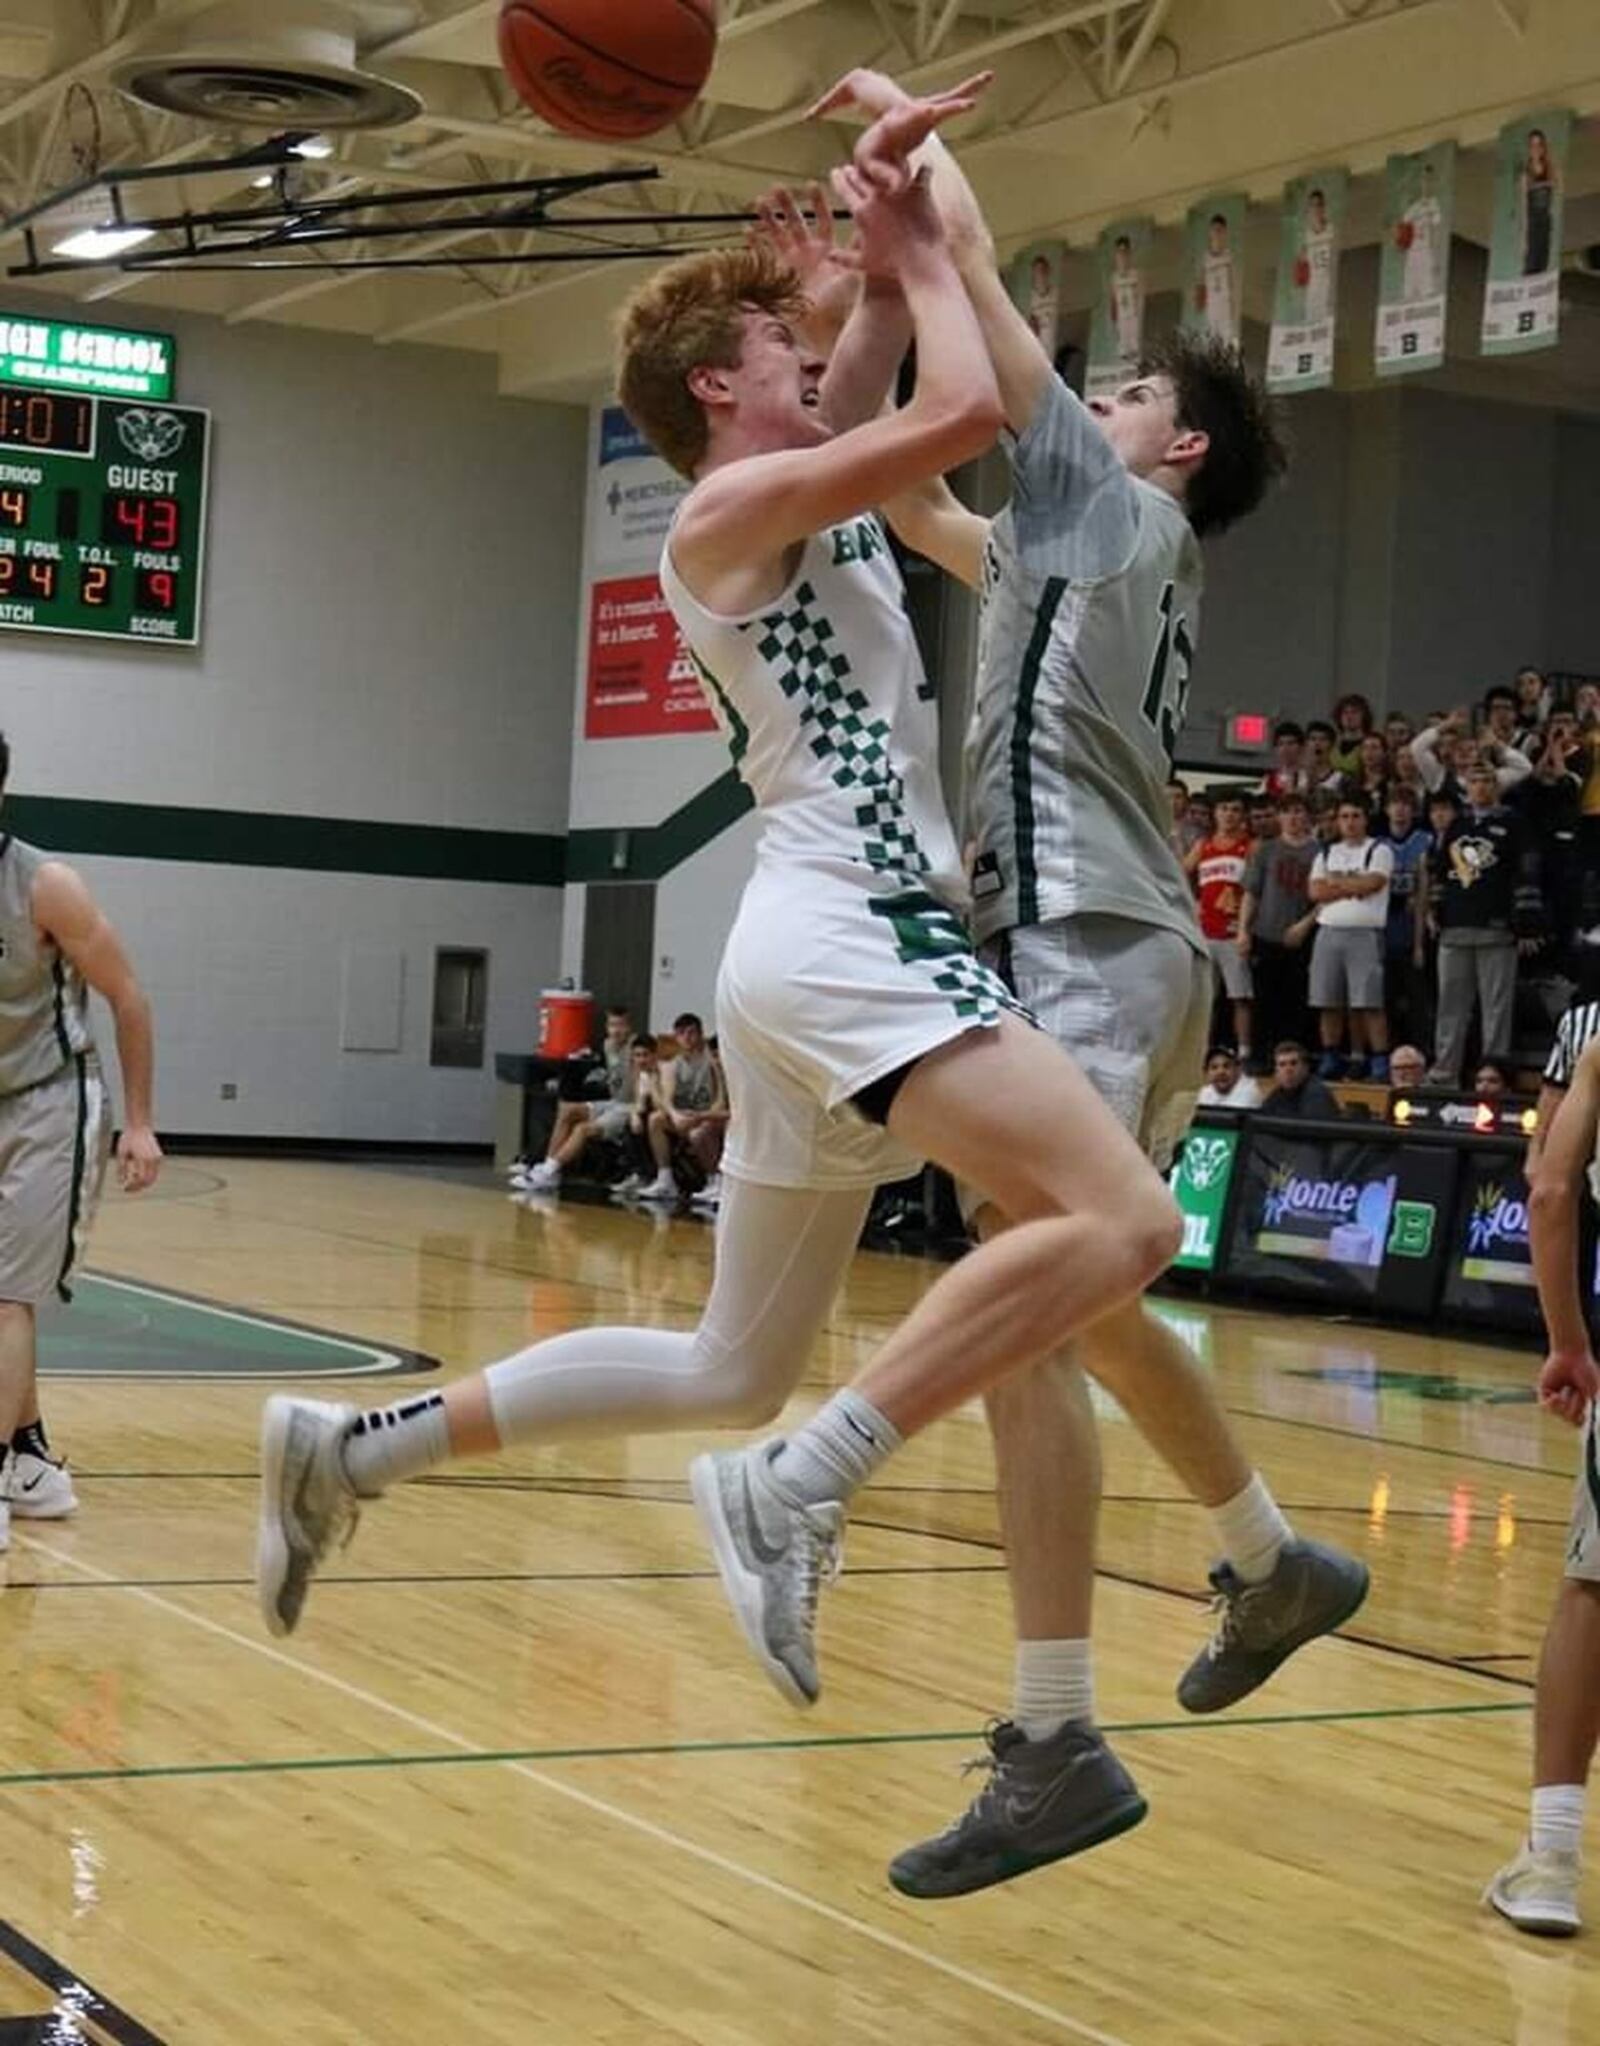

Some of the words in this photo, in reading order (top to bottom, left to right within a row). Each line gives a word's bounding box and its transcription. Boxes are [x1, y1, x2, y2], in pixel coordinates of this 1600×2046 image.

[60, 329, 167, 375] SCHOOL
[107, 464, 178, 493] GUEST
[2, 491, 24, 525] 4
[117, 499, 177, 549] 43
[24, 540, 62, 560] FOUL
[133, 551, 181, 572] FOULS
[84, 567, 107, 603] 2
[149, 574, 173, 608] 9
[130, 616, 178, 636] SCORE
[1387, 1200, 1437, 1258] B
